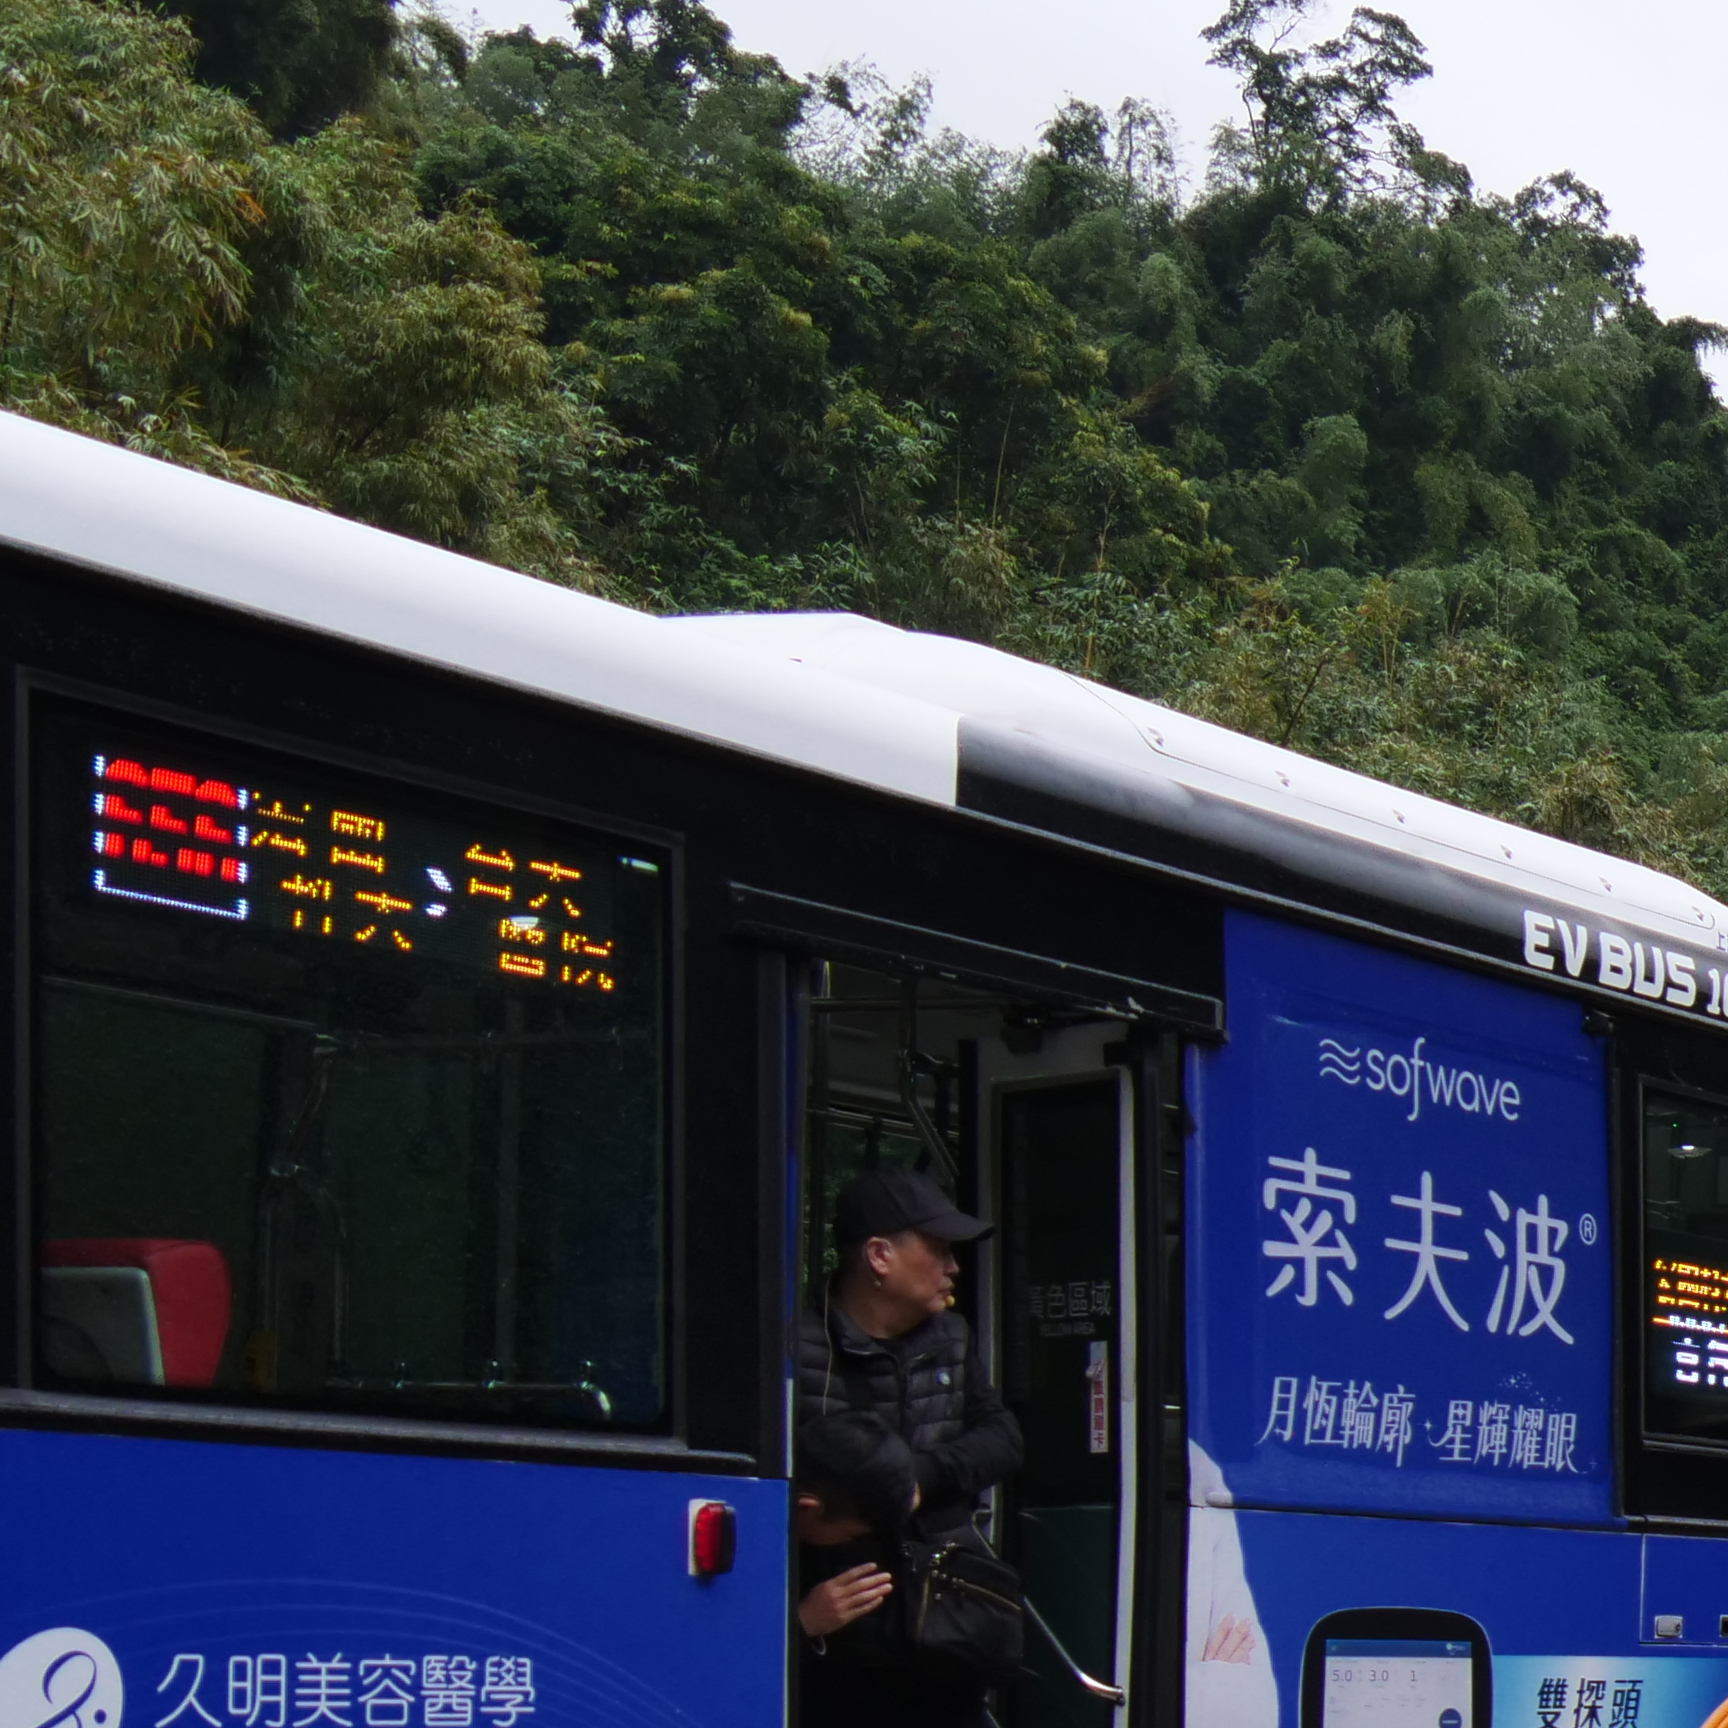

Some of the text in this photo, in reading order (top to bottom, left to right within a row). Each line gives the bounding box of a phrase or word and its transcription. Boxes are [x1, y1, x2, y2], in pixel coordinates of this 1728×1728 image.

[1523, 909, 1588, 977] EV
[1599, 932, 1697, 1007] BUS
[1366, 1036, 1521, 1121] sofwave
[1262, 1146, 1574, 1345] 索夫波
[155, 1652, 535, 1728] 久明美容醫學
[1332, 1669, 1353, 1682] 5.0
[1368, 1669, 1389, 1682] 3.0
